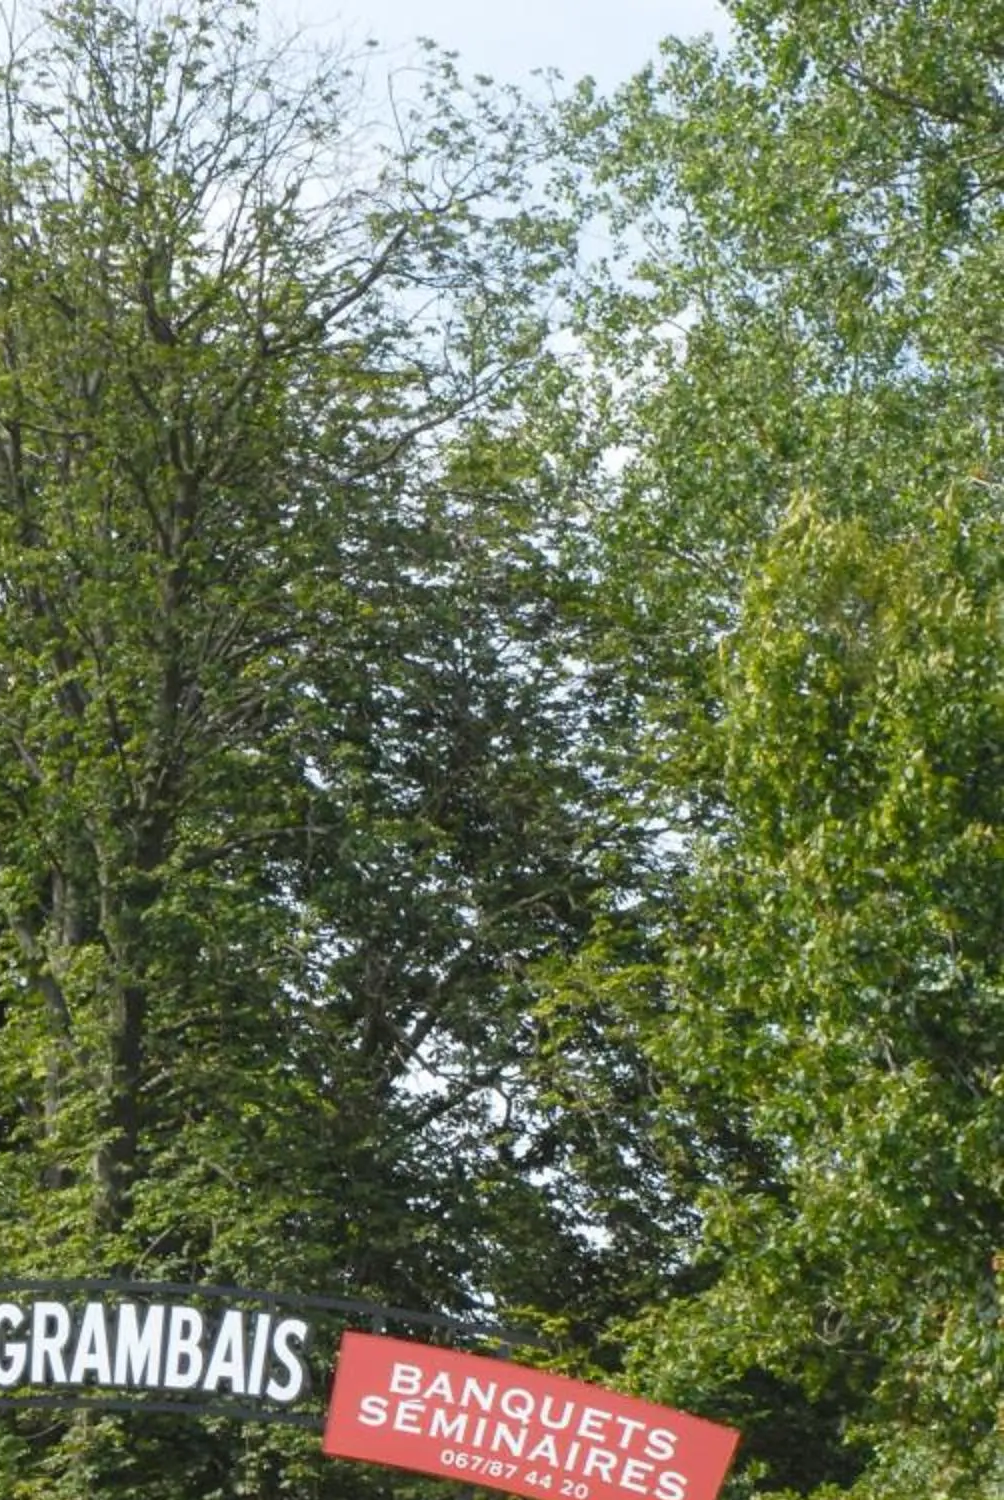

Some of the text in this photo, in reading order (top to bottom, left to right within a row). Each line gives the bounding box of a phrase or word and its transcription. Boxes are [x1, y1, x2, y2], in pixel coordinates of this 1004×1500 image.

[389, 1363, 679, 1461] BANQUETS
[441, 1448, 589, 1500] 067/87 44 20
